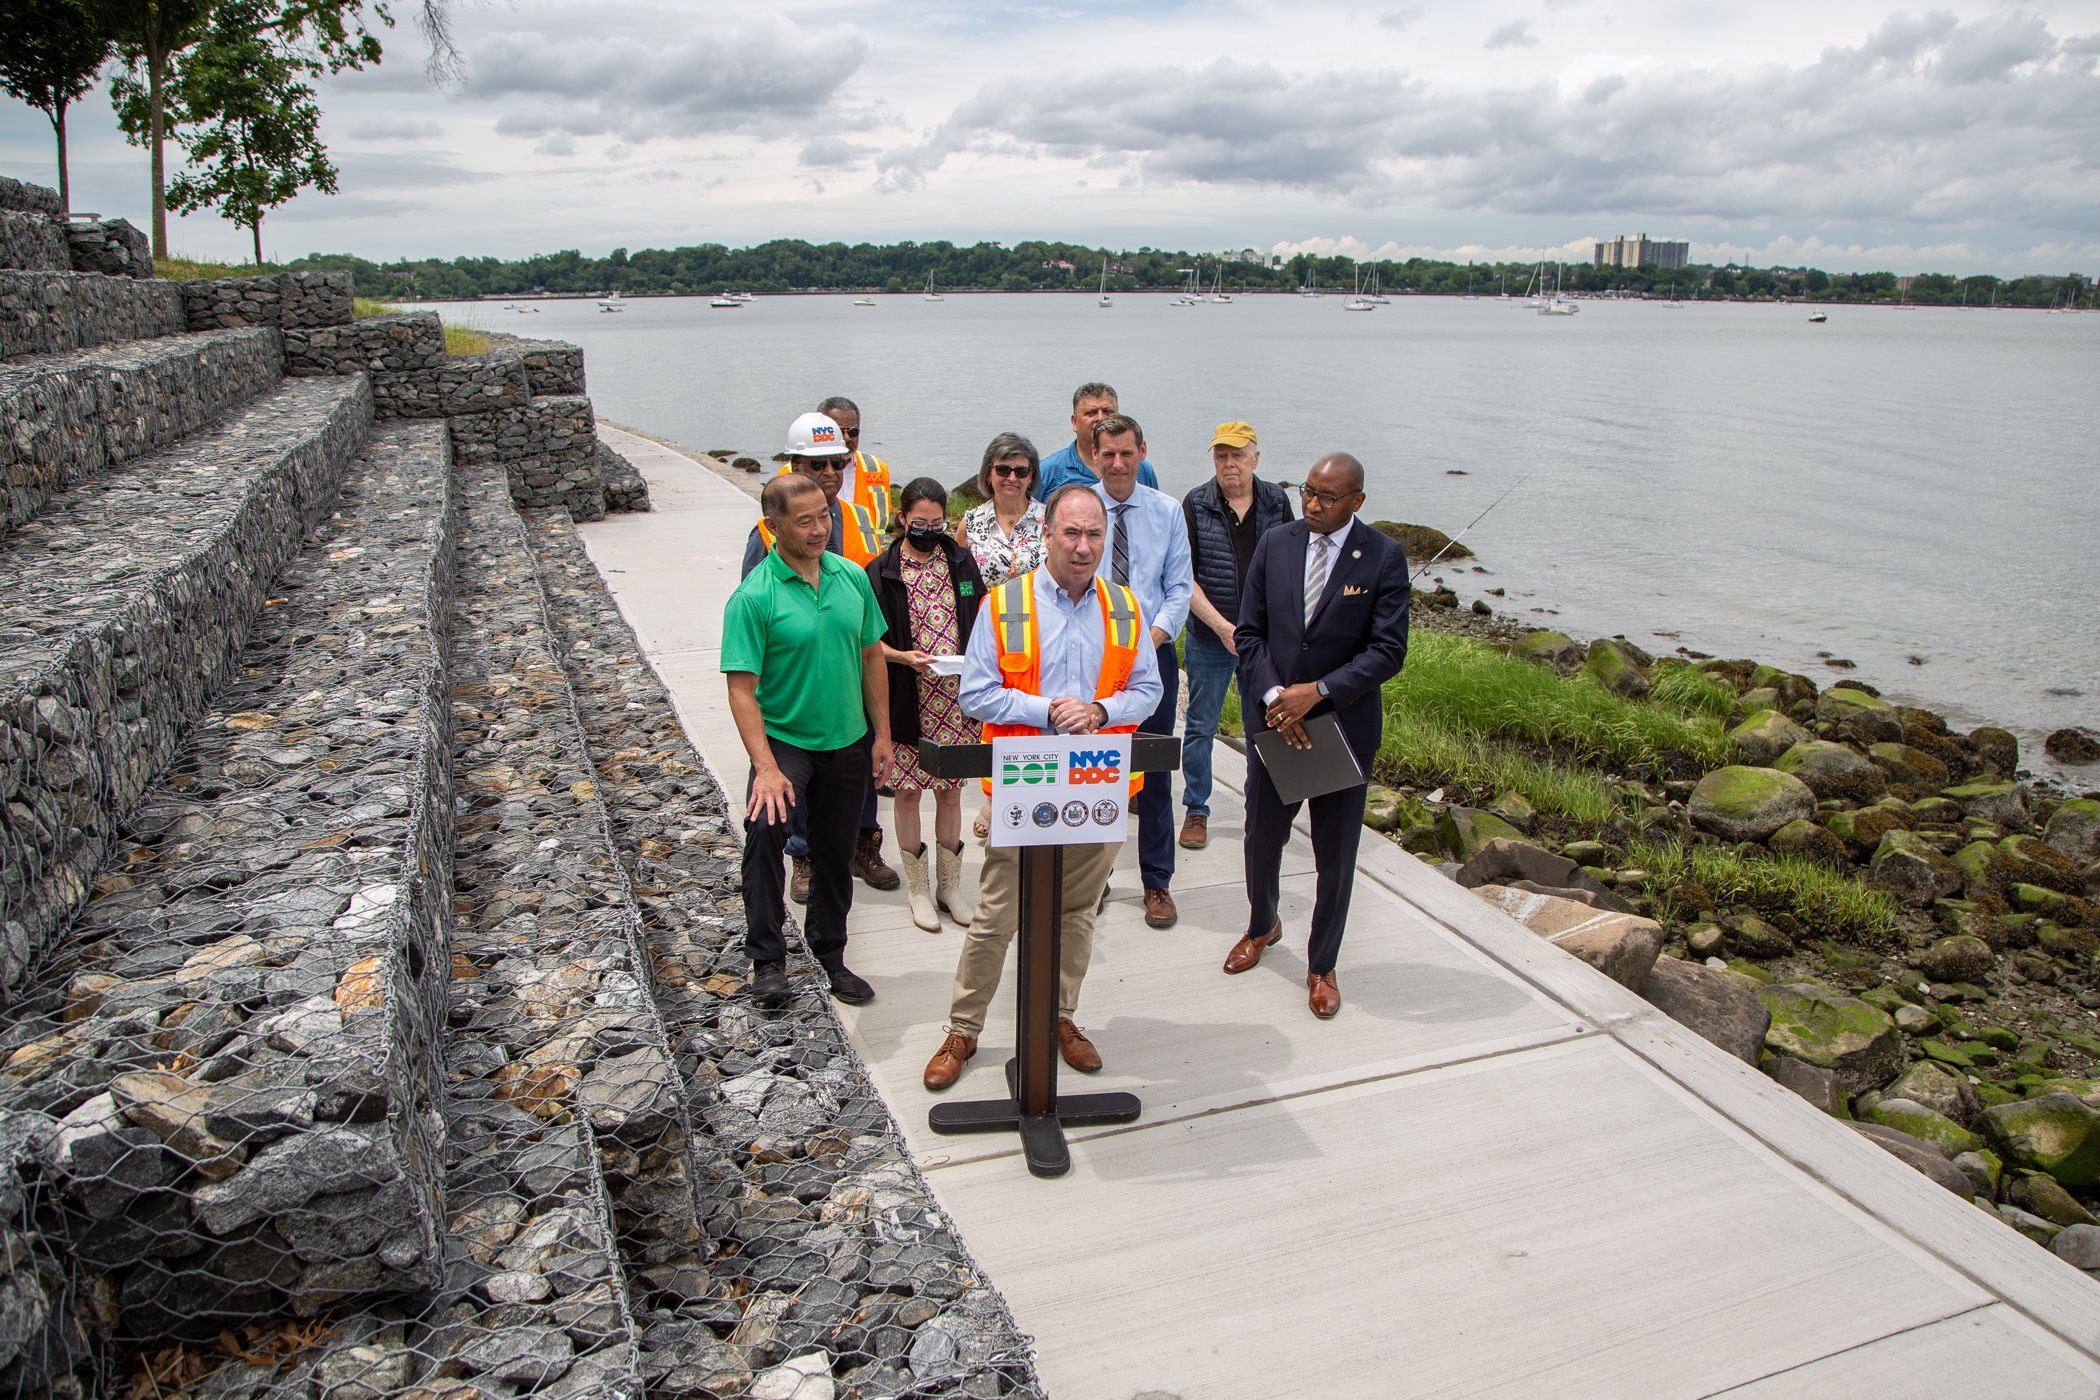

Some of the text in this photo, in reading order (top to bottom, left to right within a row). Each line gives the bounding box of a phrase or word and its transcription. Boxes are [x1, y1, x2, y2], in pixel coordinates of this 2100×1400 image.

[811, 426, 834, 434] NYC
[813, 433, 835, 442] DDC
[1069, 750, 1121, 768] NYC
[1003, 763, 1058, 785] DOT
[1069, 766, 1120, 785] DDC
